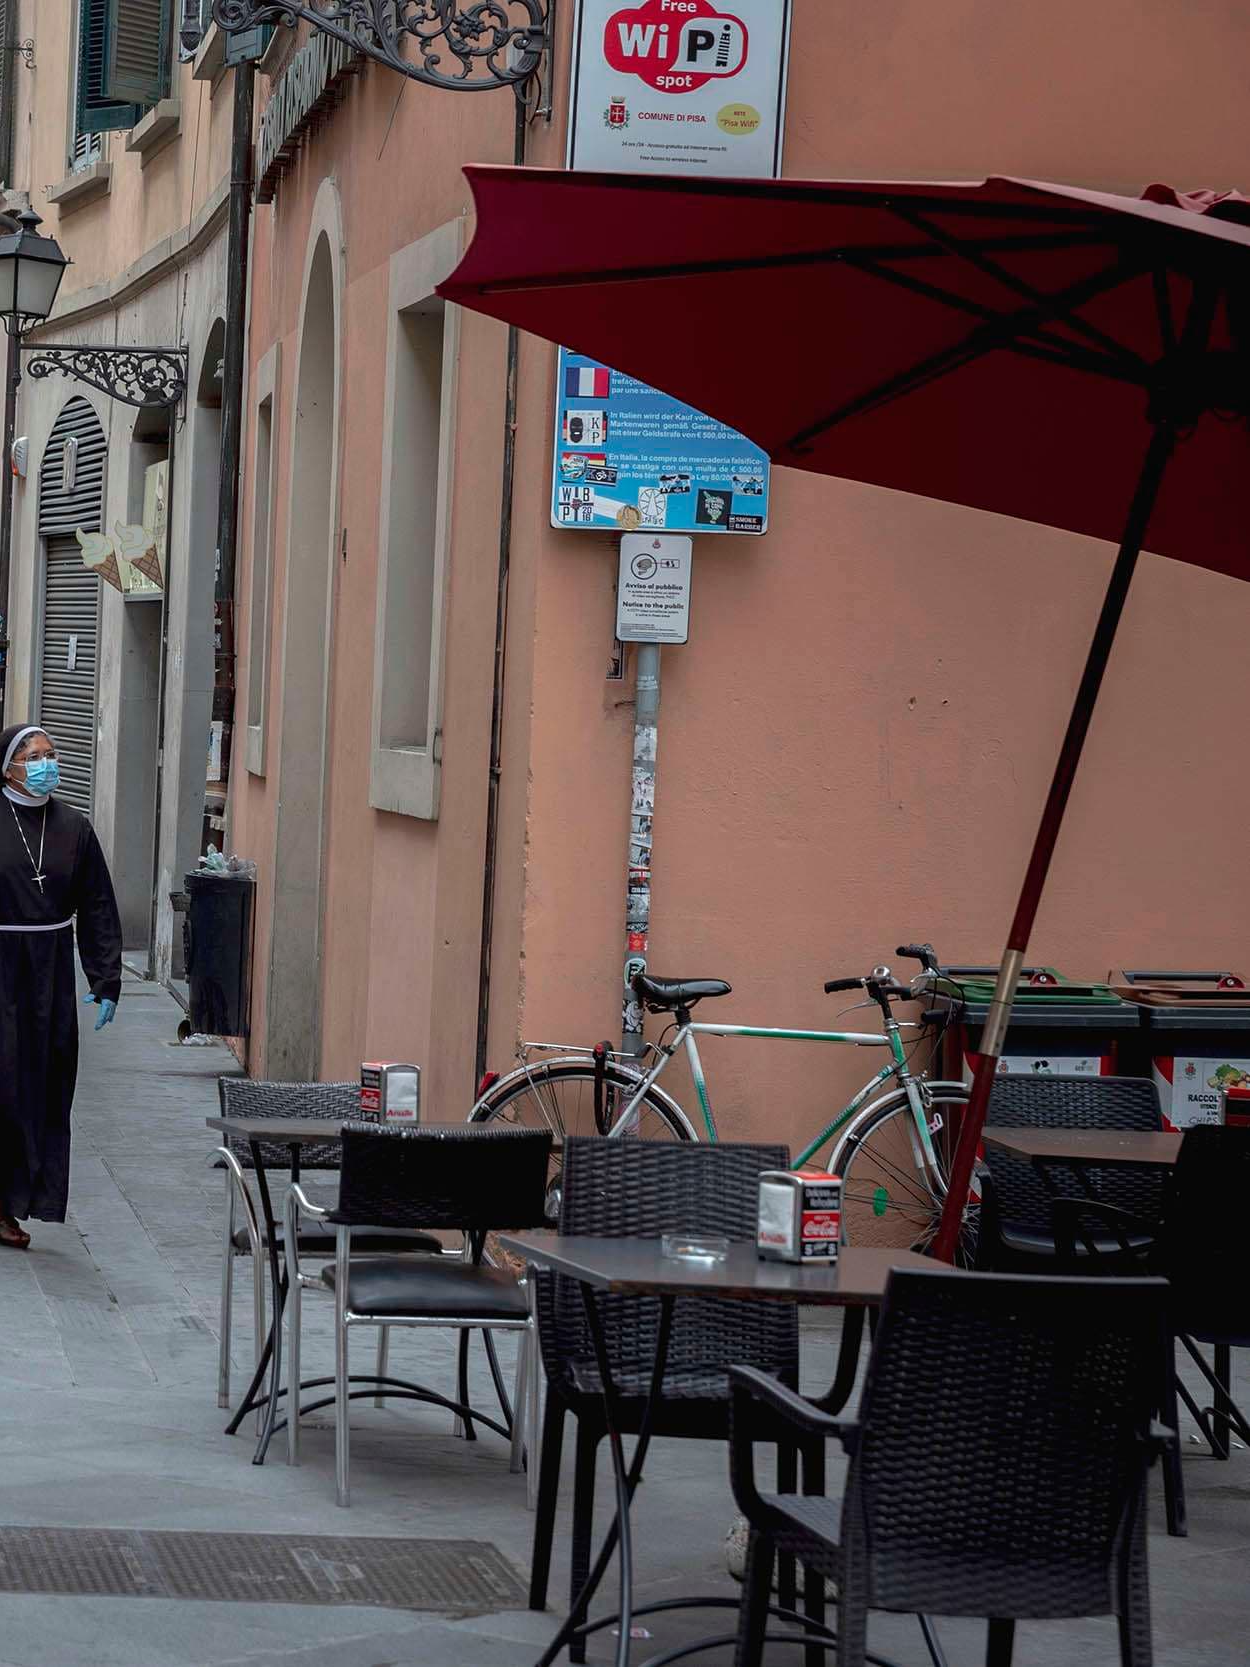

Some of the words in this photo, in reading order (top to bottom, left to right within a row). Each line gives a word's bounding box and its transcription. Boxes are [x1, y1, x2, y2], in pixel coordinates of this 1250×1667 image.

[661, 0, 697, 13] Free
[656, 75, 692, 89] spot
[638, 112, 674, 121] COMUNE
[686, 114, 707, 123] PISA
[648, 455, 678, 463] compra
